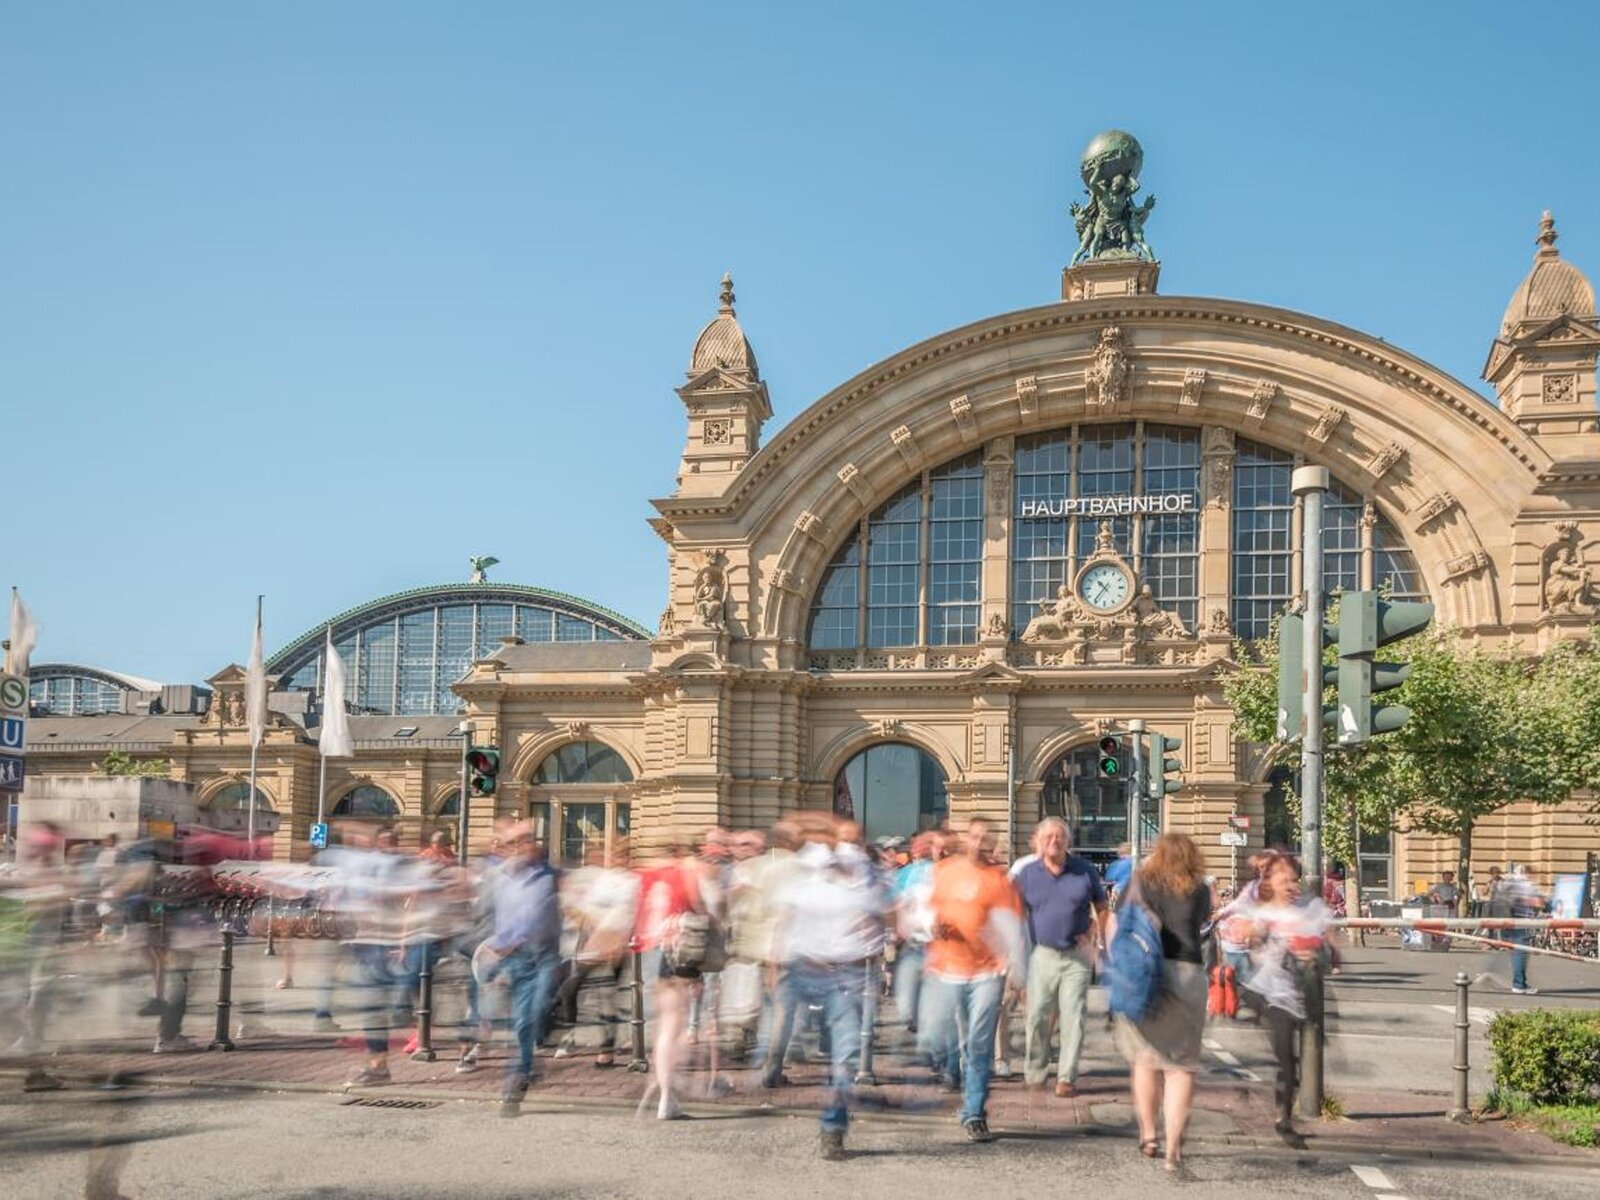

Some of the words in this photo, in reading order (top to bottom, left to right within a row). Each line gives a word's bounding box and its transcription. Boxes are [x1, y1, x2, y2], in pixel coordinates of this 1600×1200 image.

[1022, 494, 1192, 516] HAUPTBAHNHOF
[3, 680, 22, 707] S
[3, 720, 20, 746] U
[312, 825, 321, 839] P
